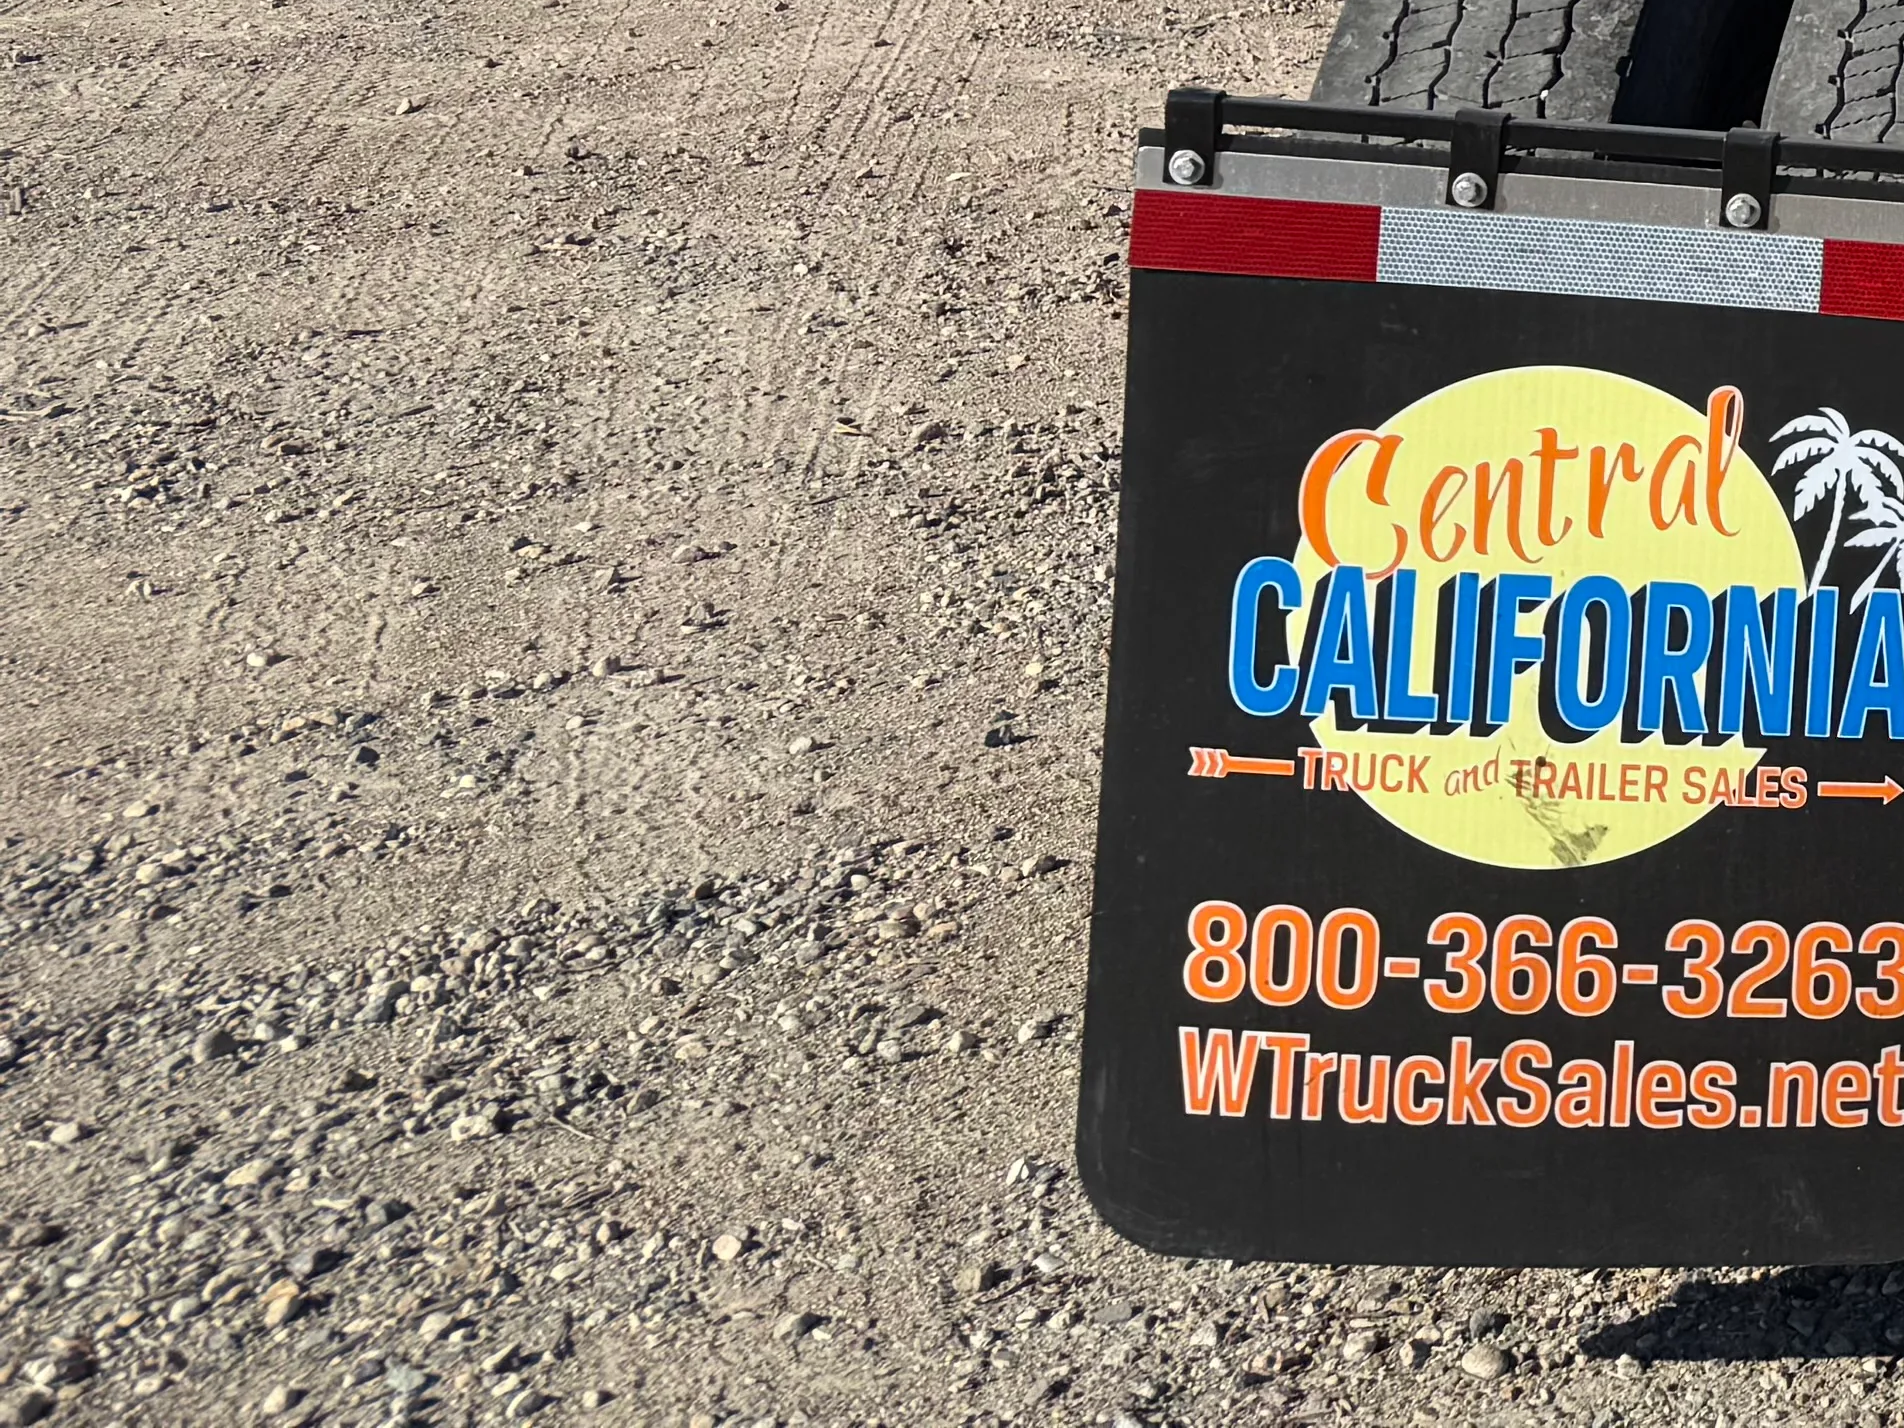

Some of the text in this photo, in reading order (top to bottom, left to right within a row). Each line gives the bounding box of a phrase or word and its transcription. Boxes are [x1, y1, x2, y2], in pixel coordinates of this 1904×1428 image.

[1299, 385, 1744, 581] Central
[1297, 748, 1808, 809] TRUCK and TRAILER SALES
